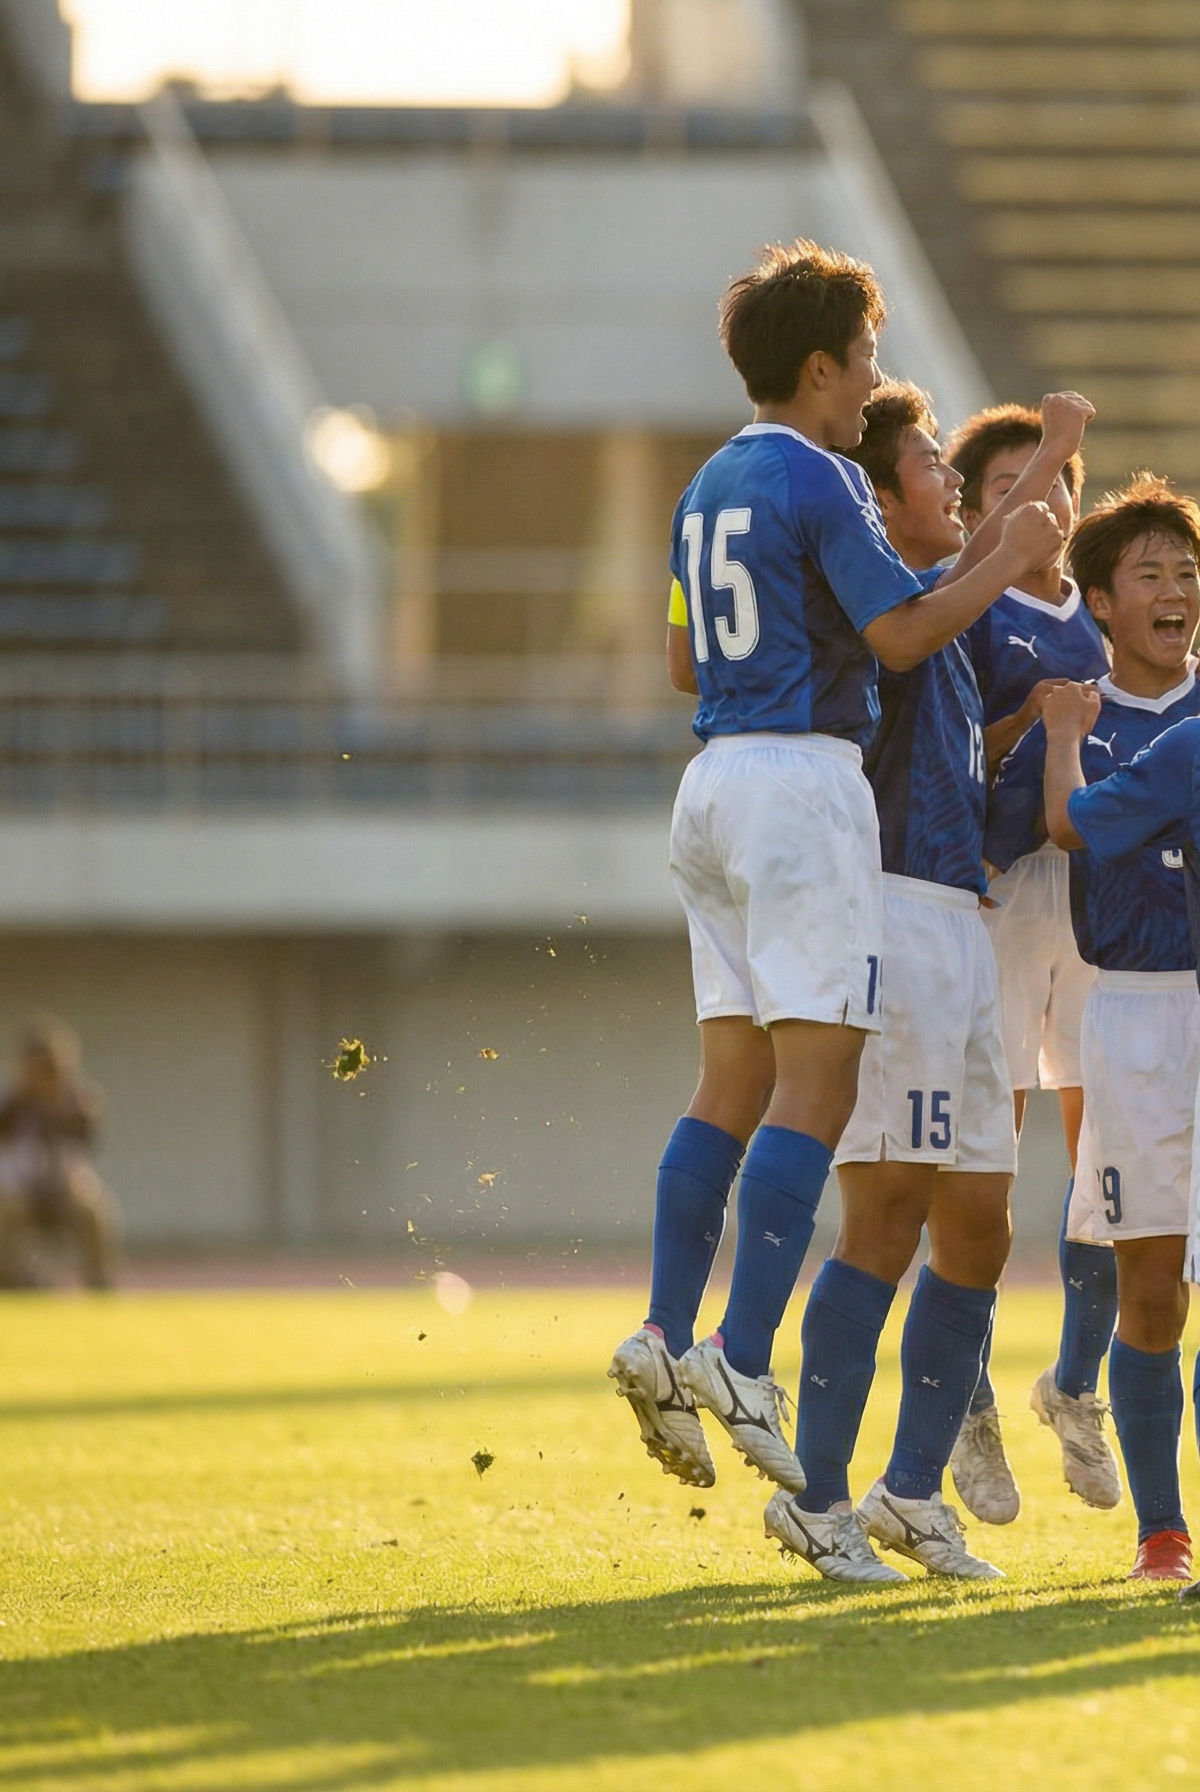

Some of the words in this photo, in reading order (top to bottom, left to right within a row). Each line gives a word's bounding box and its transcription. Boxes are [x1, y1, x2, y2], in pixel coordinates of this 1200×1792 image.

[681, 508, 760, 663] 15
[907, 1089, 952, 1149] 15
[1102, 1166, 1122, 1224] 9
